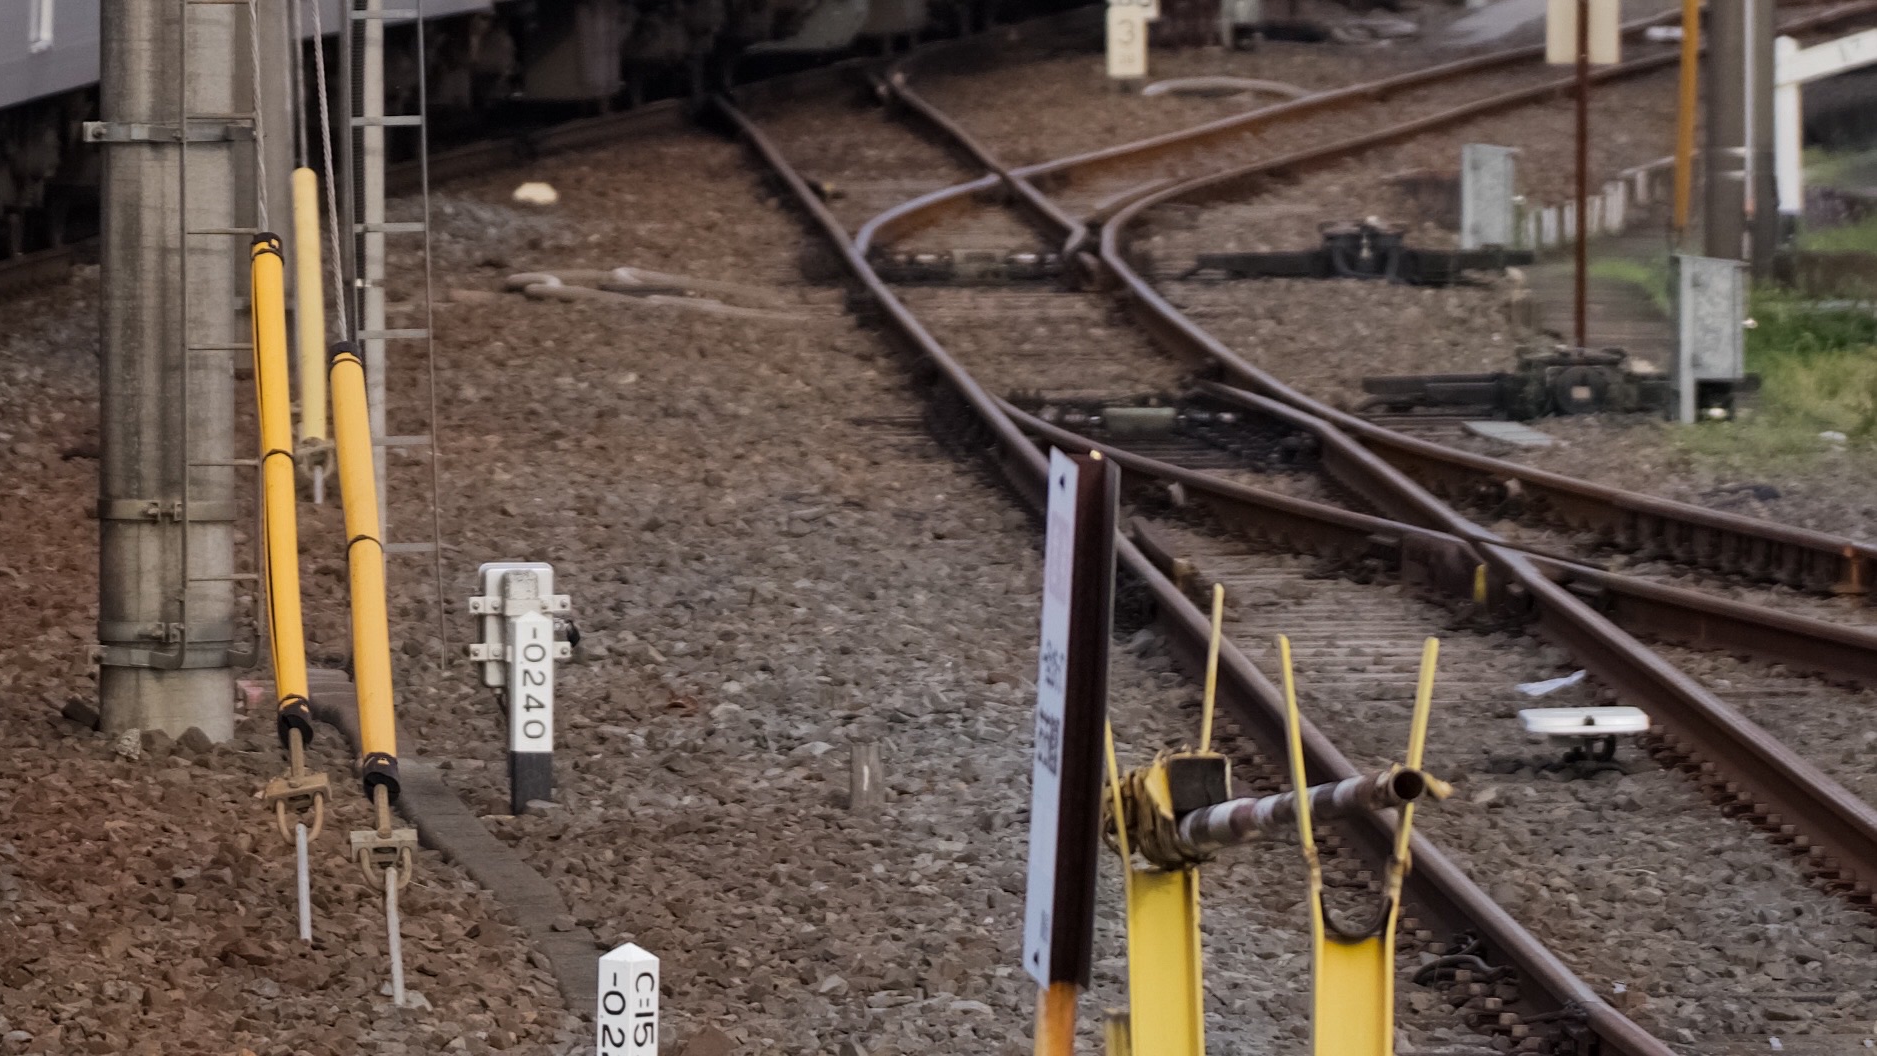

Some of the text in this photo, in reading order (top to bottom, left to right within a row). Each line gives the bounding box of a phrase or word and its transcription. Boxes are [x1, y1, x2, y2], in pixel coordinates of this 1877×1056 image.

[1117, 18, 1135, 45] 3
[522, 627, 547, 740] -0240
[602, 972, 626, 1056] -02
